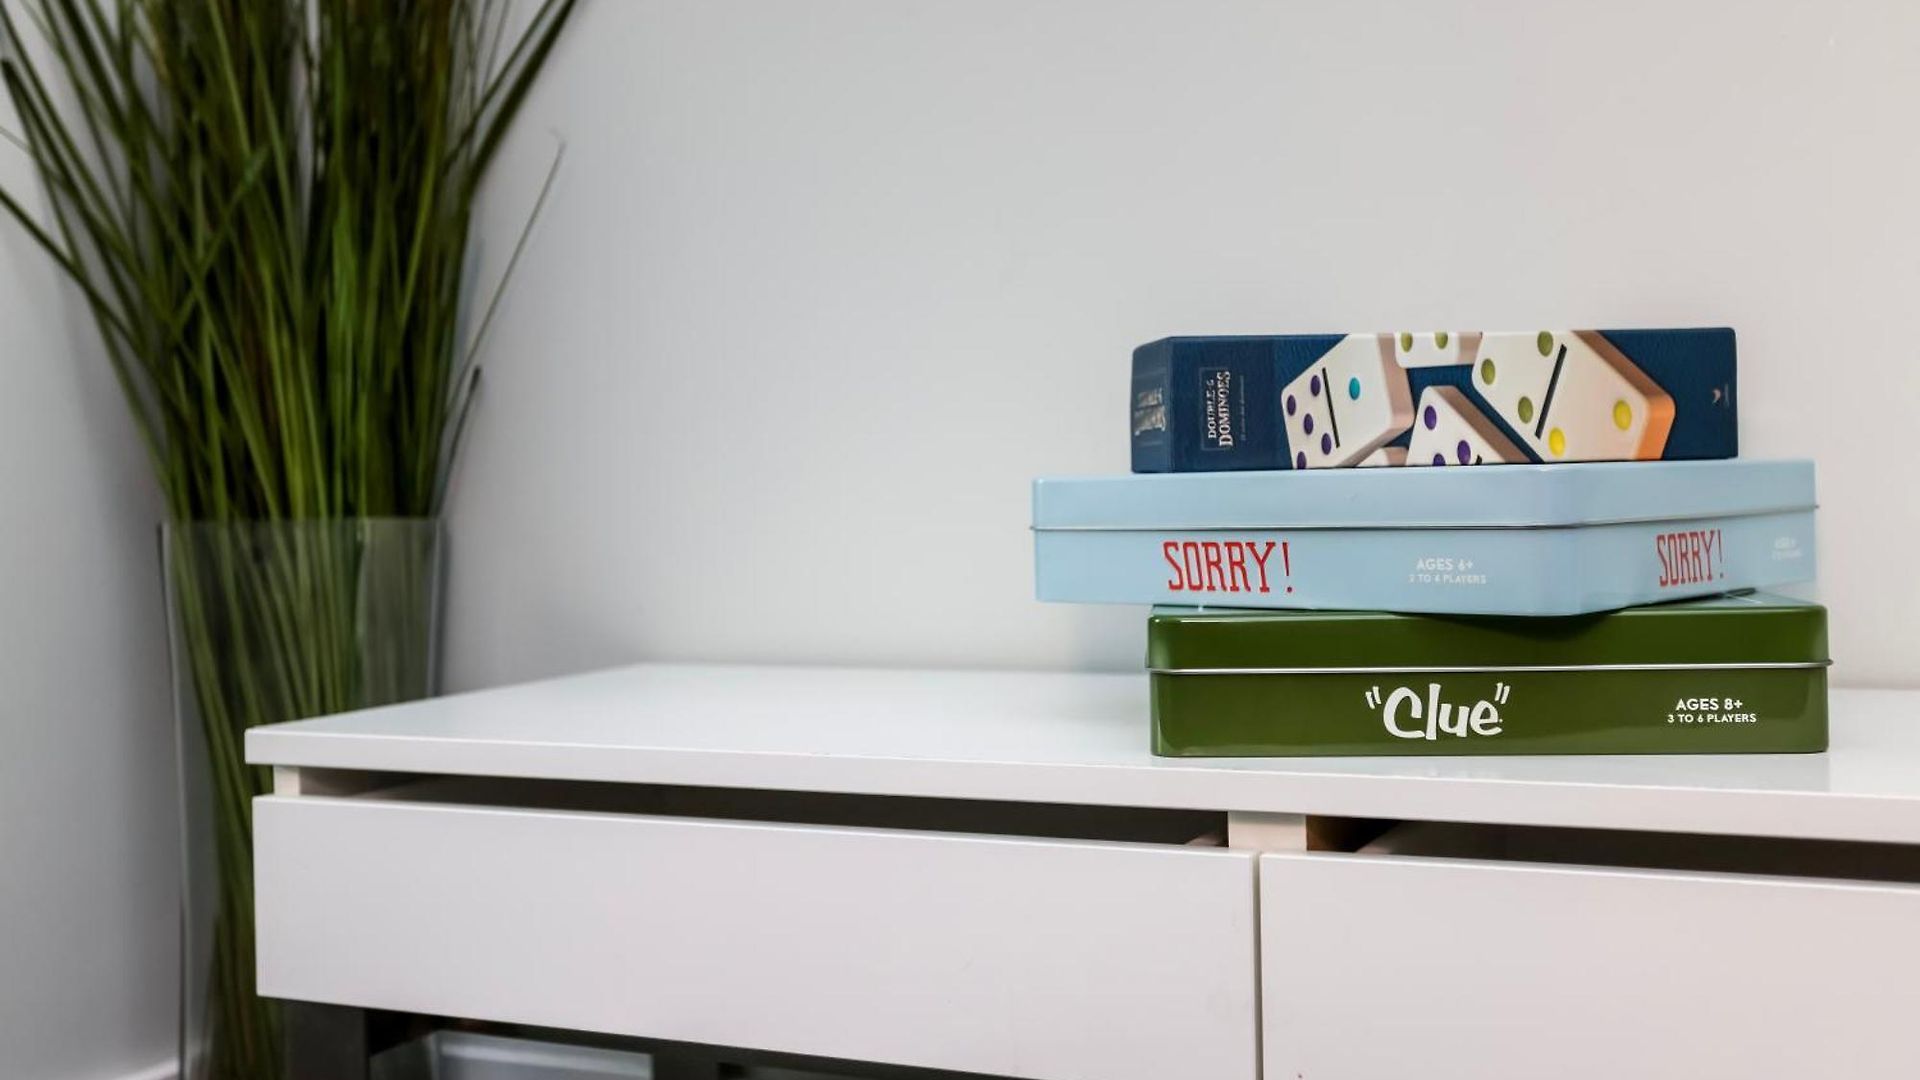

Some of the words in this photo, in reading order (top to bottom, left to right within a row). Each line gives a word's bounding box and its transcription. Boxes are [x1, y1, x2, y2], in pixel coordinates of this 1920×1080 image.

[1217, 371, 1233, 446] DOMINOES
[1416, 558, 1454, 571] AGES
[1457, 559, 1474, 571] 6+
[1656, 529, 1724, 587] SORRY!
[1163, 541, 1292, 593] SORRY!
[1417, 574, 1432, 584] TO
[1443, 575, 1486, 584] PLAYERS
[1675, 698, 1719, 711] AGES
[1723, 698, 1743, 711] 8+
[1667, 714, 1675, 724] 3
[1678, 714, 1694, 723] TO
[1697, 714, 1704, 723] 6
[1706, 713, 1757, 723] PLAYERS
